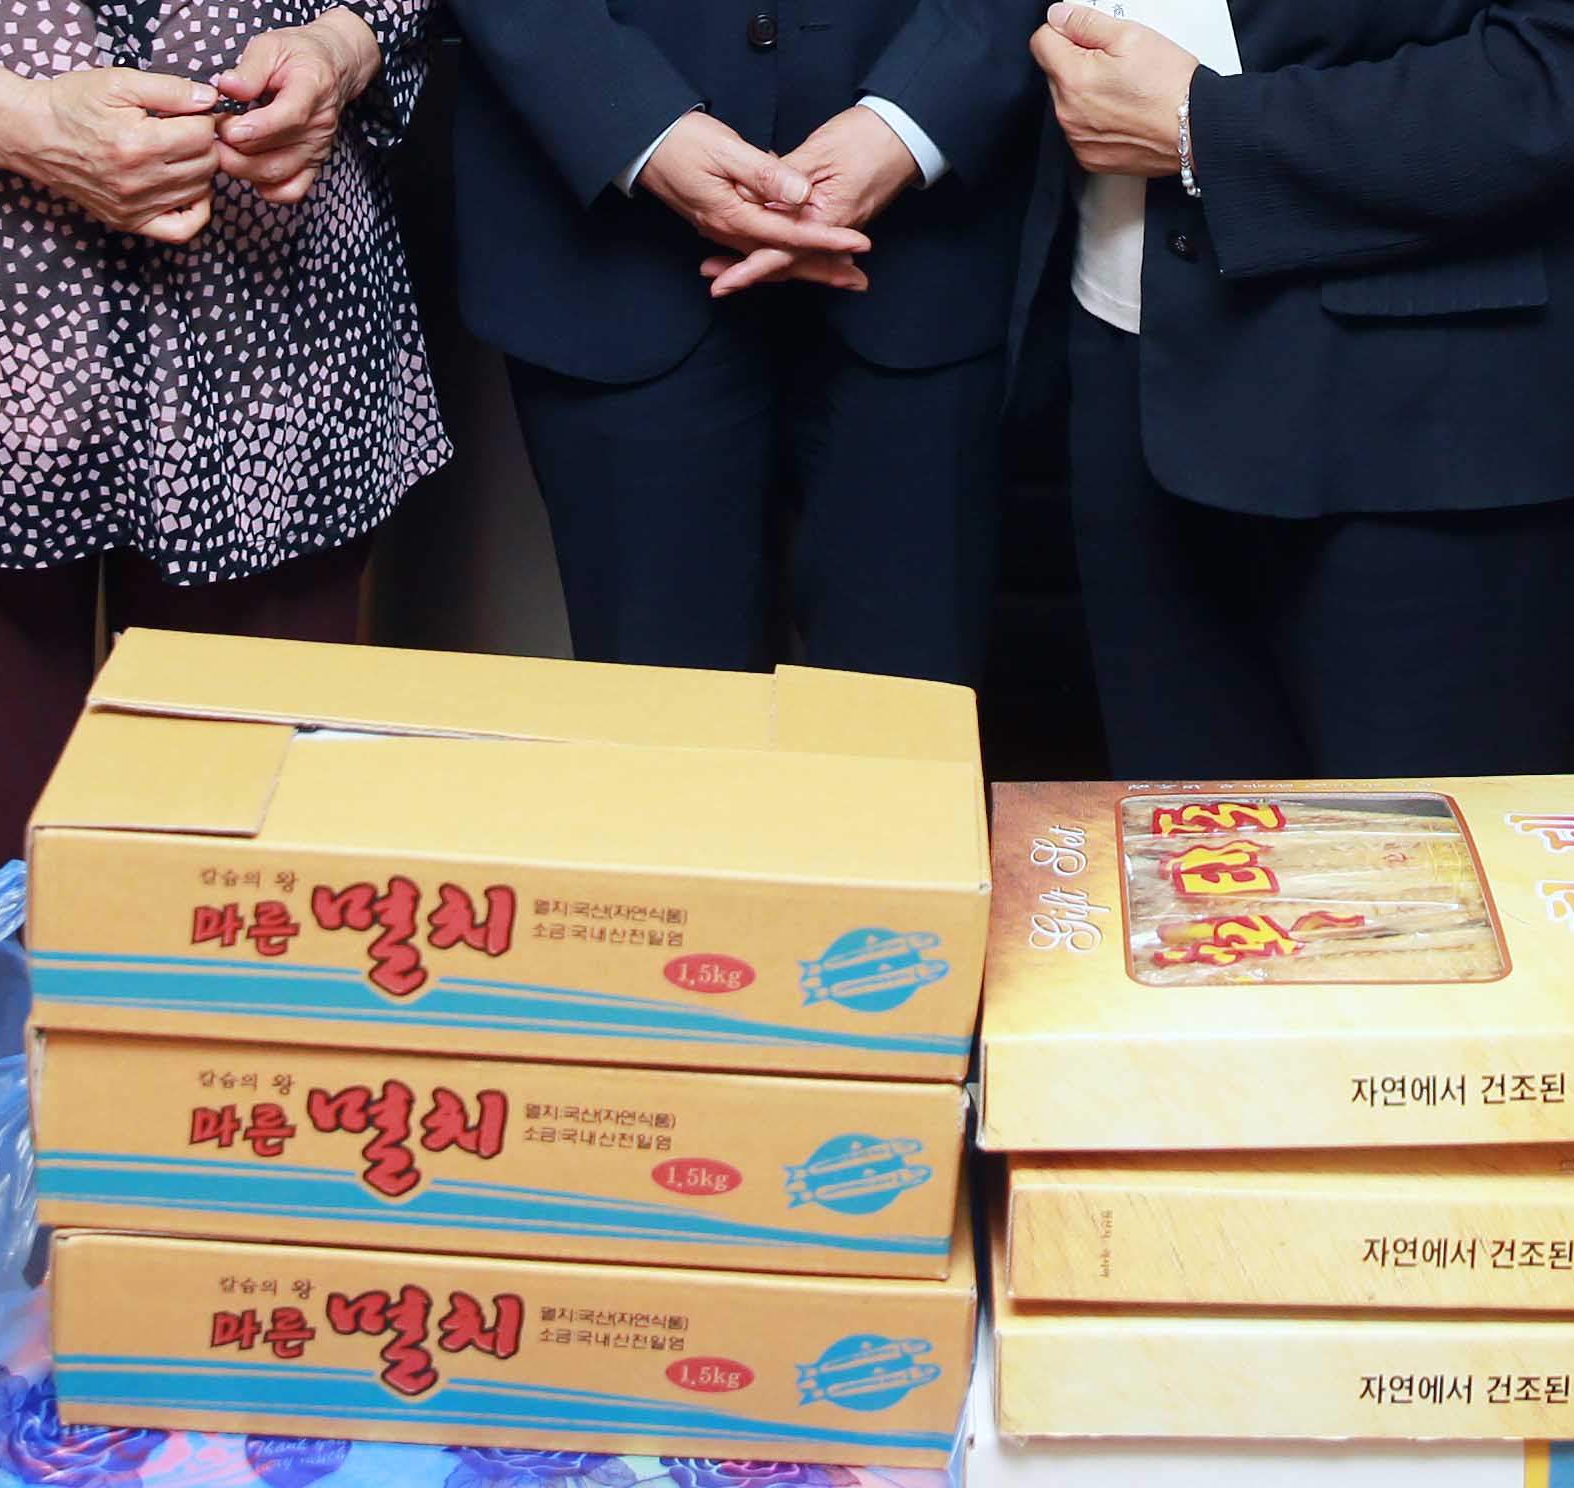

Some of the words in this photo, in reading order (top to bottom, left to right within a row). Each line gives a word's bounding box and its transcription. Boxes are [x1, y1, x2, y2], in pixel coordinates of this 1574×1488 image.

[1029, 824, 1087, 878] Set
[191, 900, 301, 957] 마른
[310, 874, 516, 997] 멸치
[1029, 885, 1112, 953] Gift
[676, 961, 743, 990] 1.5kg
[1351, 1074, 1467, 1107] 자연에서
[1480, 1071, 1566, 1105] 건조된
[189, 1103, 297, 1157] 마른
[307, 1079, 509, 1198] 멸치
[664, 1167, 730, 1193] 1.5kg
[1362, 1236, 1477, 1270] 자연에서
[1491, 1237, 1574, 1271] 건조된
[211, 1306, 316, 1359] 마른
[326, 1283, 525, 1397] 멸치
[680, 1363, 742, 1389] 1.5kg
[1359, 1374, 1474, 1406] 자연에서
[1487, 1373, 1571, 1405] 건조된
